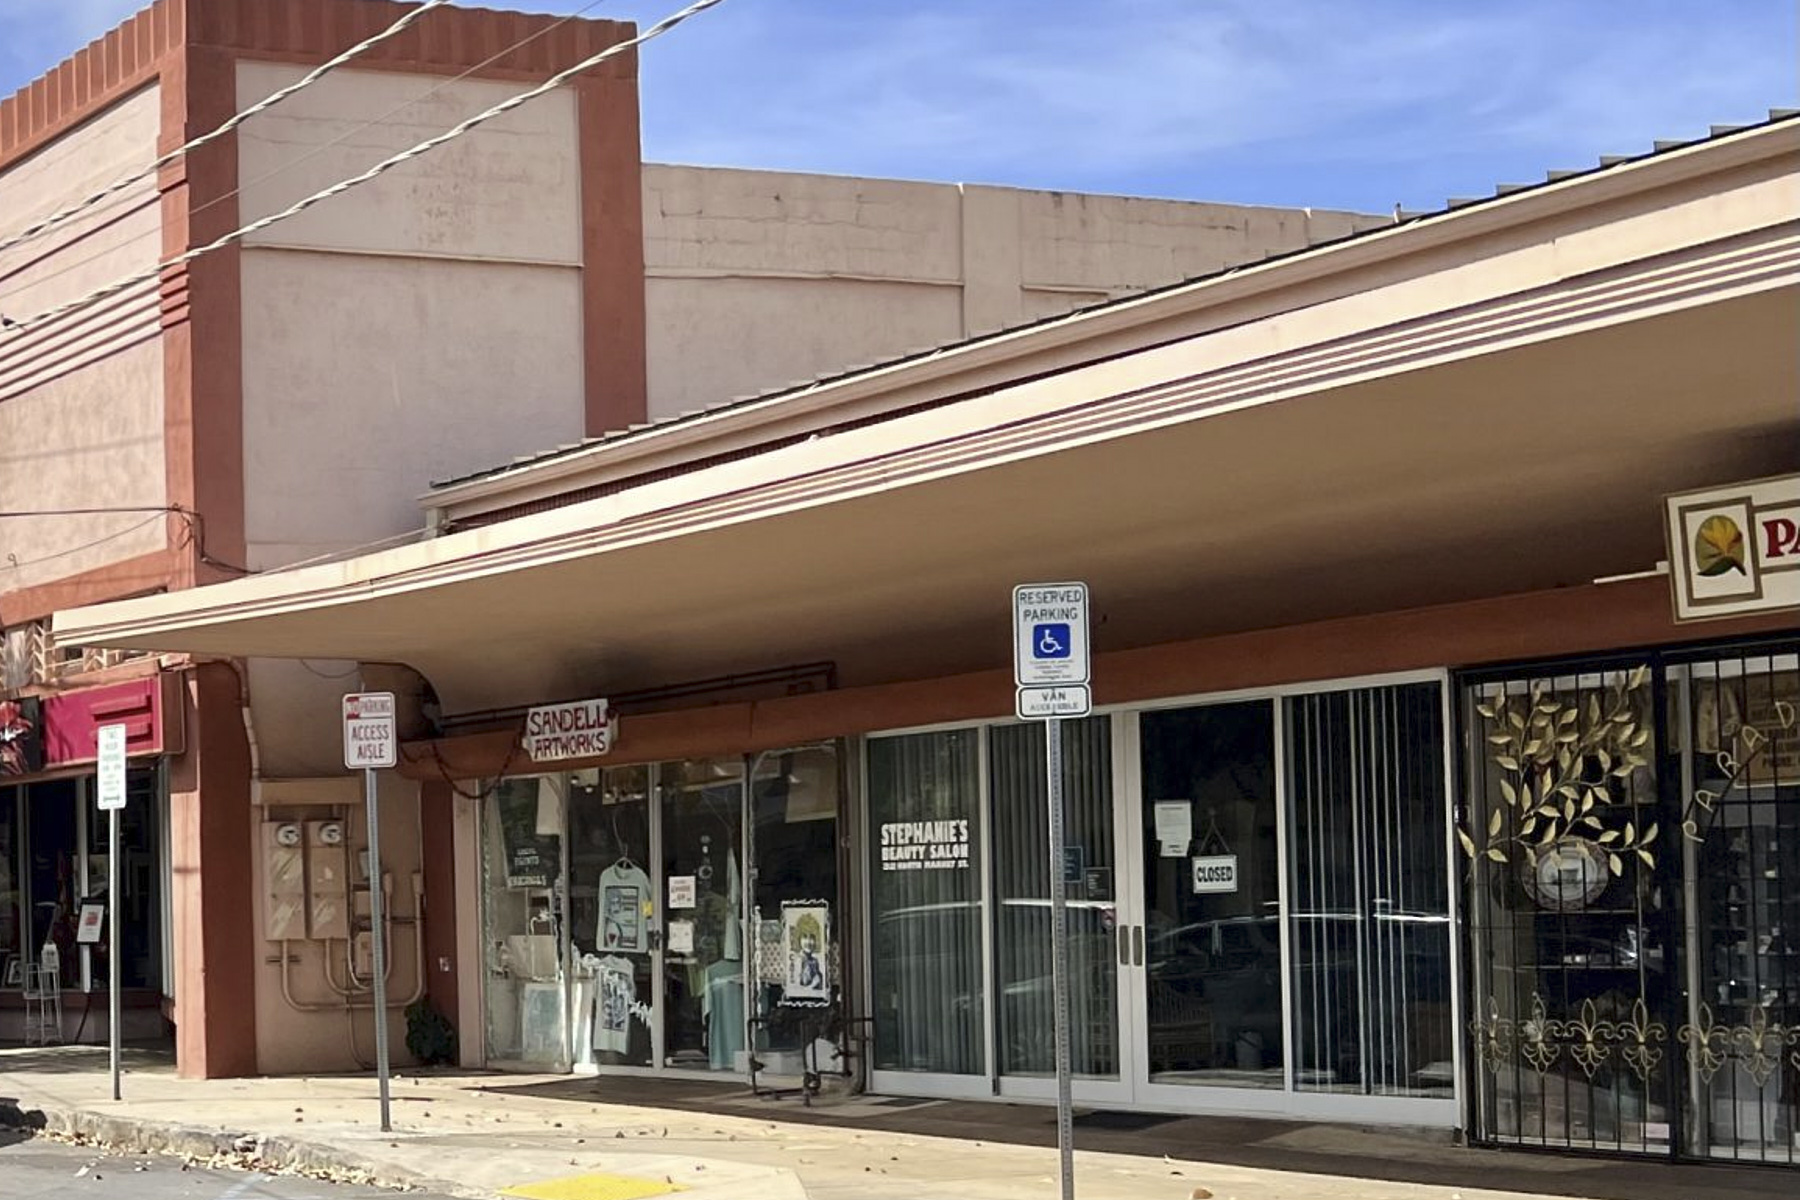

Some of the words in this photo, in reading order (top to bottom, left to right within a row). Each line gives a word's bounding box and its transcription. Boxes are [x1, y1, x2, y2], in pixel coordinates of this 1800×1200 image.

[1020, 590, 1082, 605] RESERVED
[1023, 607, 1078, 621] PARKING
[1042, 691, 1066, 702] VAN
[529, 705, 608, 736] SANDELL
[352, 725, 390, 741] ACCESS
[358, 743, 385, 759] AISLE
[534, 731, 606, 759] ARTWORKS
[881, 820, 969, 845] STEPHANIE'S
[882, 846, 926, 861] BEAUTY
[930, 844, 969, 859] SALON
[1197, 866, 1234, 882] CLOSED
